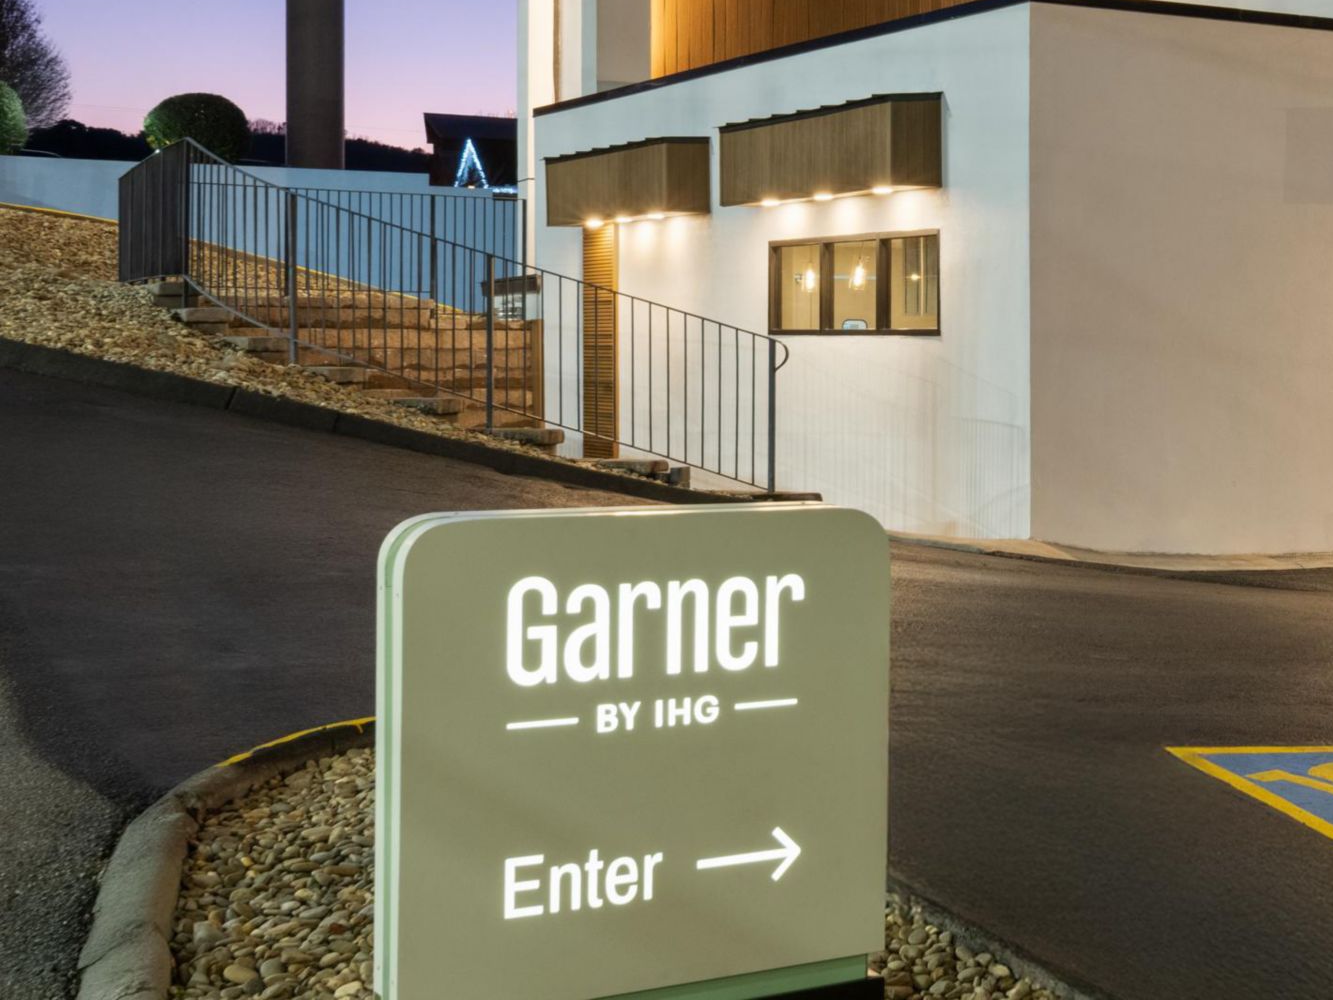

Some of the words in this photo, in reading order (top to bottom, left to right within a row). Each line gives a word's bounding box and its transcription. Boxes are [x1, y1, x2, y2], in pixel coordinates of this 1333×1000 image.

[505, 572, 806, 687] Garner
[595, 700, 643, 734] BY
[653, 693, 721, 729] IHG
[502, 848, 664, 921] Enter
